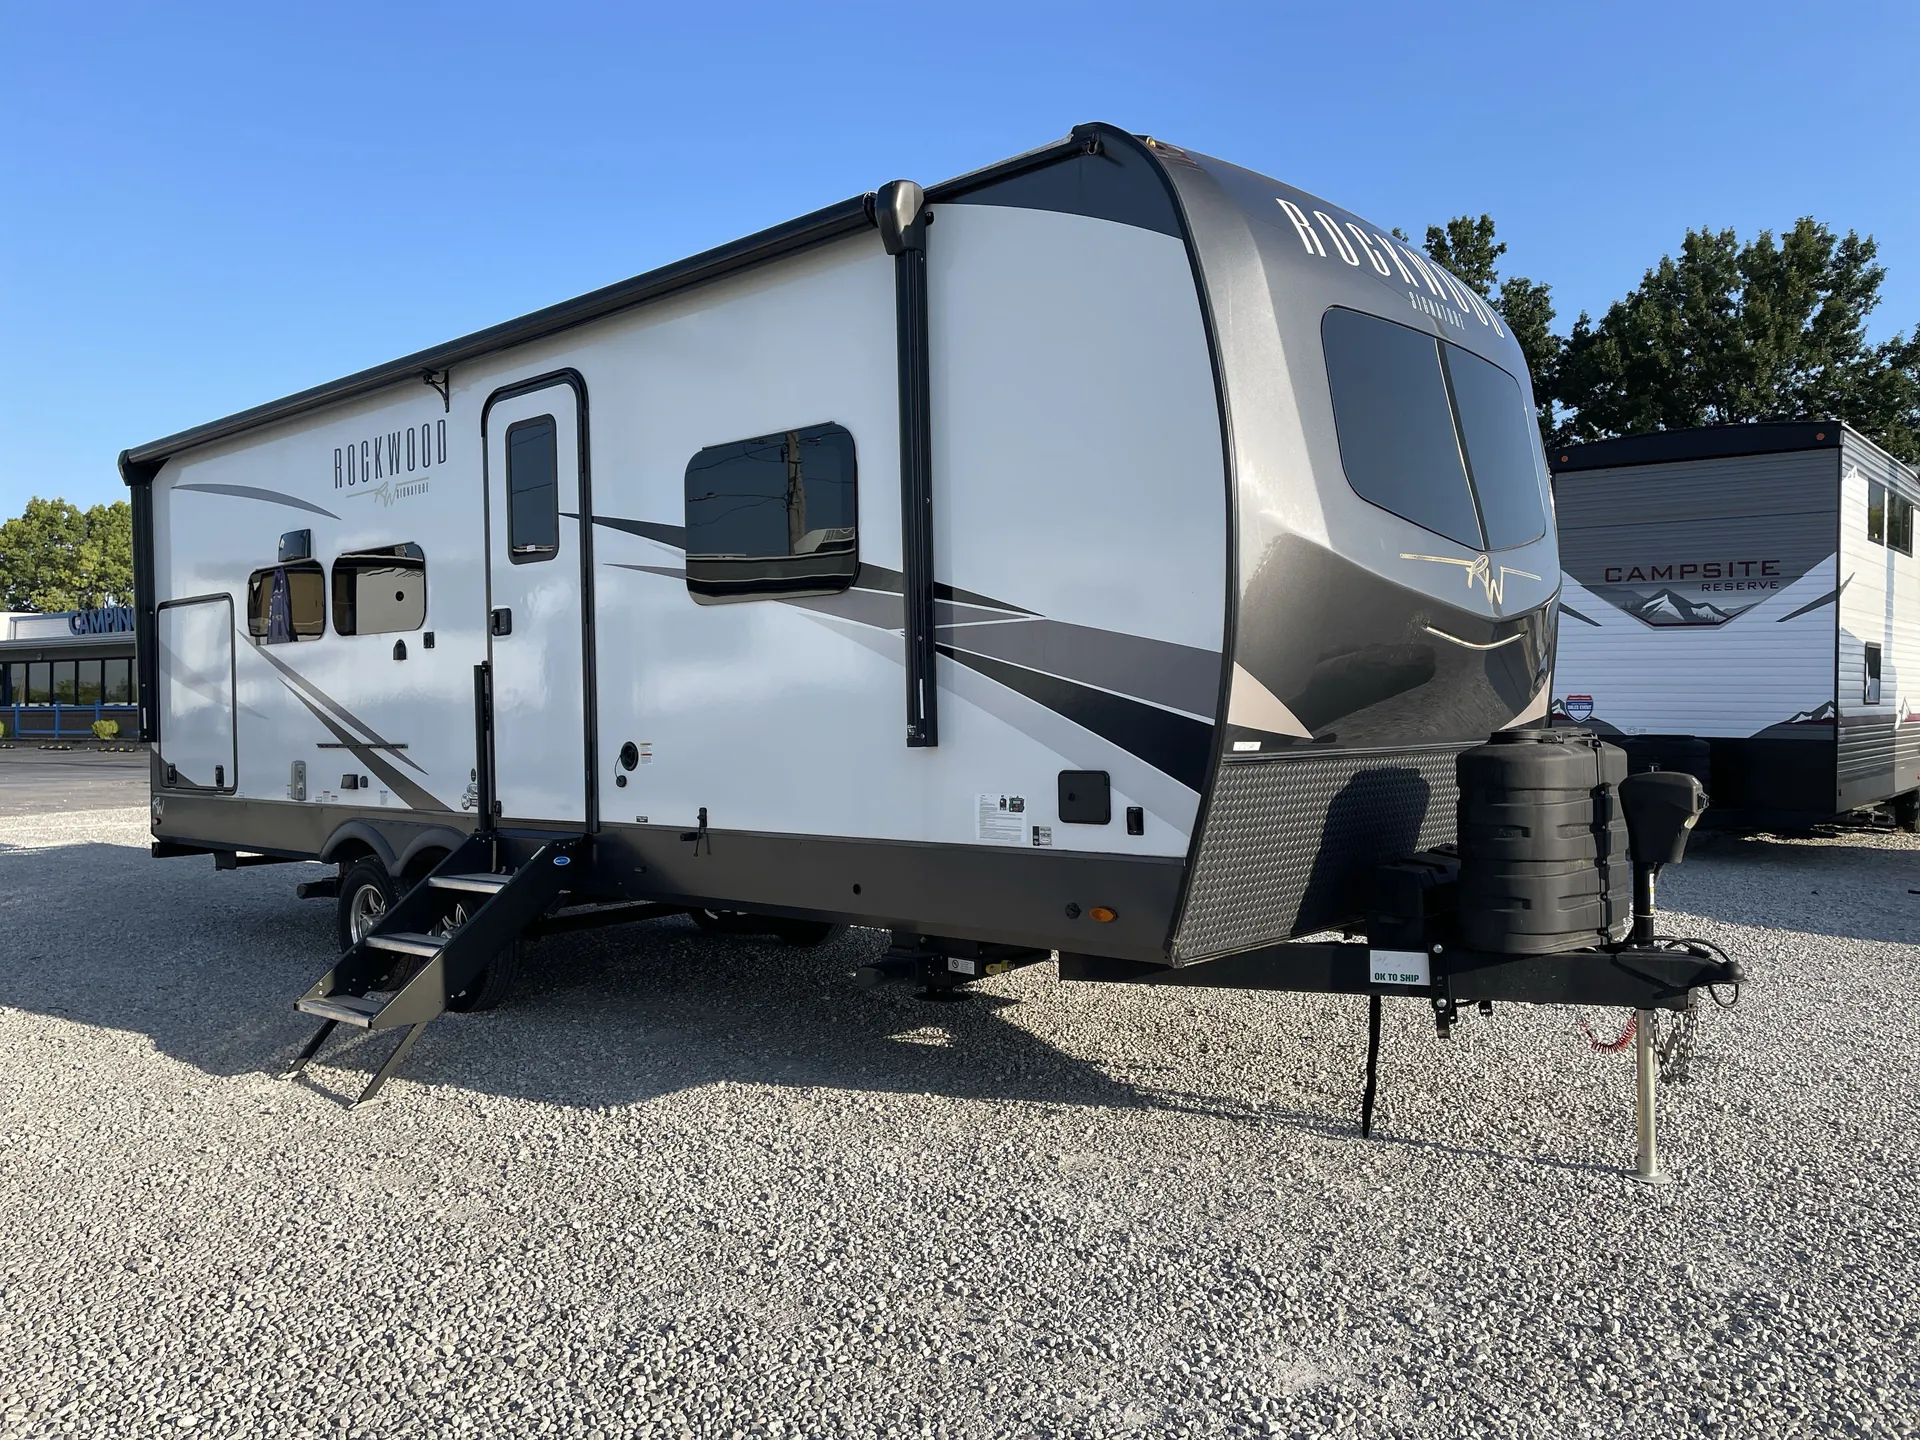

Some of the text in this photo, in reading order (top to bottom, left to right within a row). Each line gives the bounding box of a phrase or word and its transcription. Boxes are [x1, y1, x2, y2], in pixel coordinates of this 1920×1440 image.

[1275, 197, 1505, 339] ROCKWOOD
[1408, 291, 1465, 331] SIGNATURE
[334, 418, 447, 490] ROCKWOOD
[1604, 559, 1781, 583] CAMPSITE
[1701, 580, 1779, 592] RESERVE
[1374, 972, 1419, 983] OK TO SHIP
